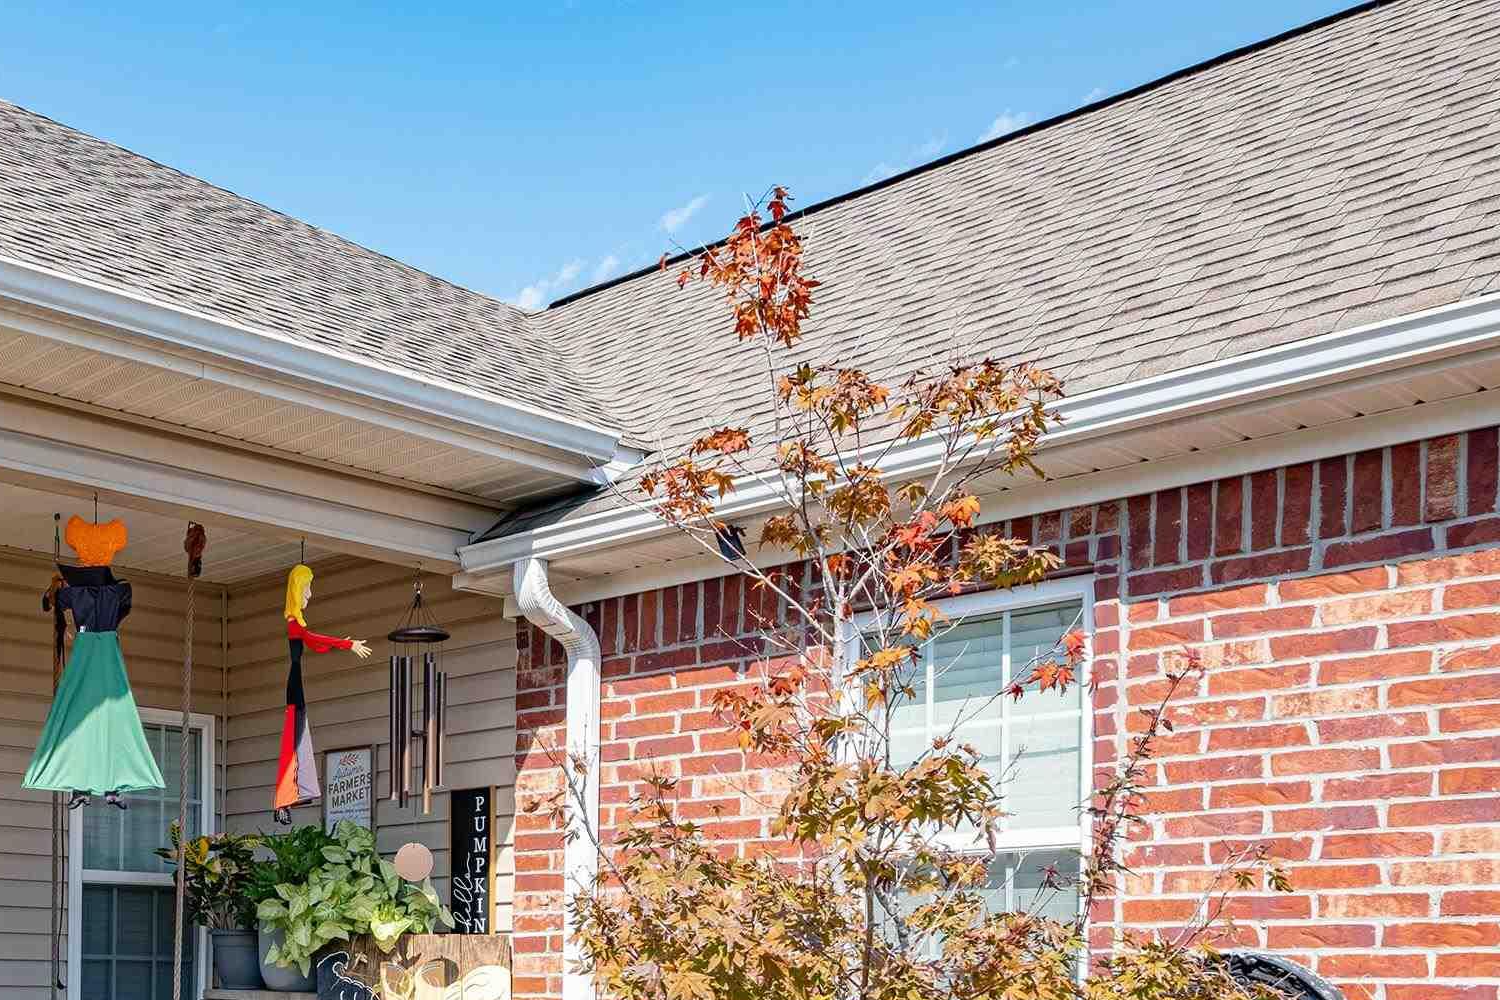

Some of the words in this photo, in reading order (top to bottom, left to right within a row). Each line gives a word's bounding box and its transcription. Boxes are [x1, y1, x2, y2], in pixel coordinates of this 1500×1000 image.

[328, 772, 372, 795] FARMERS
[332, 786, 371, 809] MARKET
[473, 796, 487, 933] PUMPKIN
